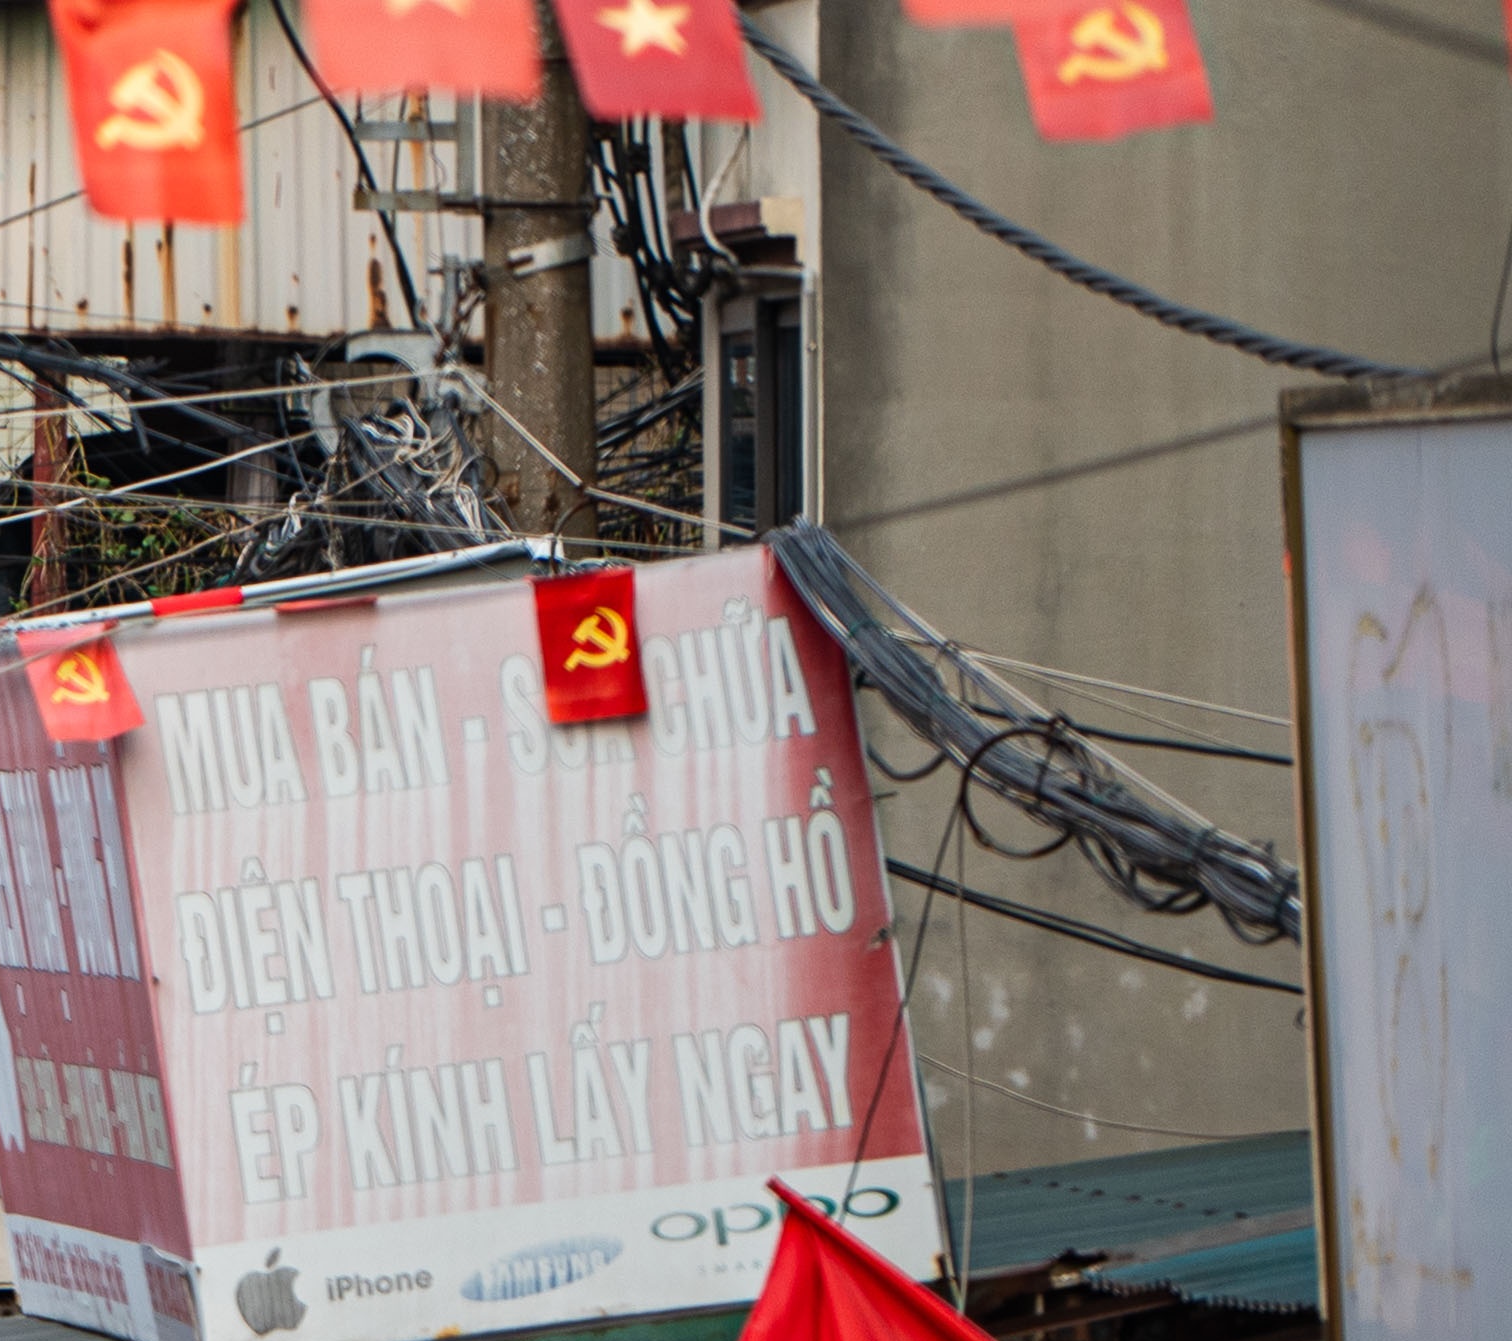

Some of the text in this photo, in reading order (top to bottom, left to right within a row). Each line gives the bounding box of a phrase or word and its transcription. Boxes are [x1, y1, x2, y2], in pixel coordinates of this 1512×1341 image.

[154, 683, 309, 815] MUA
[310, 642, 452, 798] BÁN
[650, 594, 817, 759] CHỮA
[175, 856, 336, 1037] ĐIỆN
[337, 851, 532, 1010] THOẠI
[577, 793, 759, 968] ĐỒNG
[766, 767, 860, 939] HỒ
[229, 1062, 320, 1205] ÉP
[337, 1046, 520, 1192] KÍNH
[528, 1003, 654, 1168] LẤY
[670, 1011, 855, 1149] NGAY
[325, 1263, 434, 1303] iPhone
